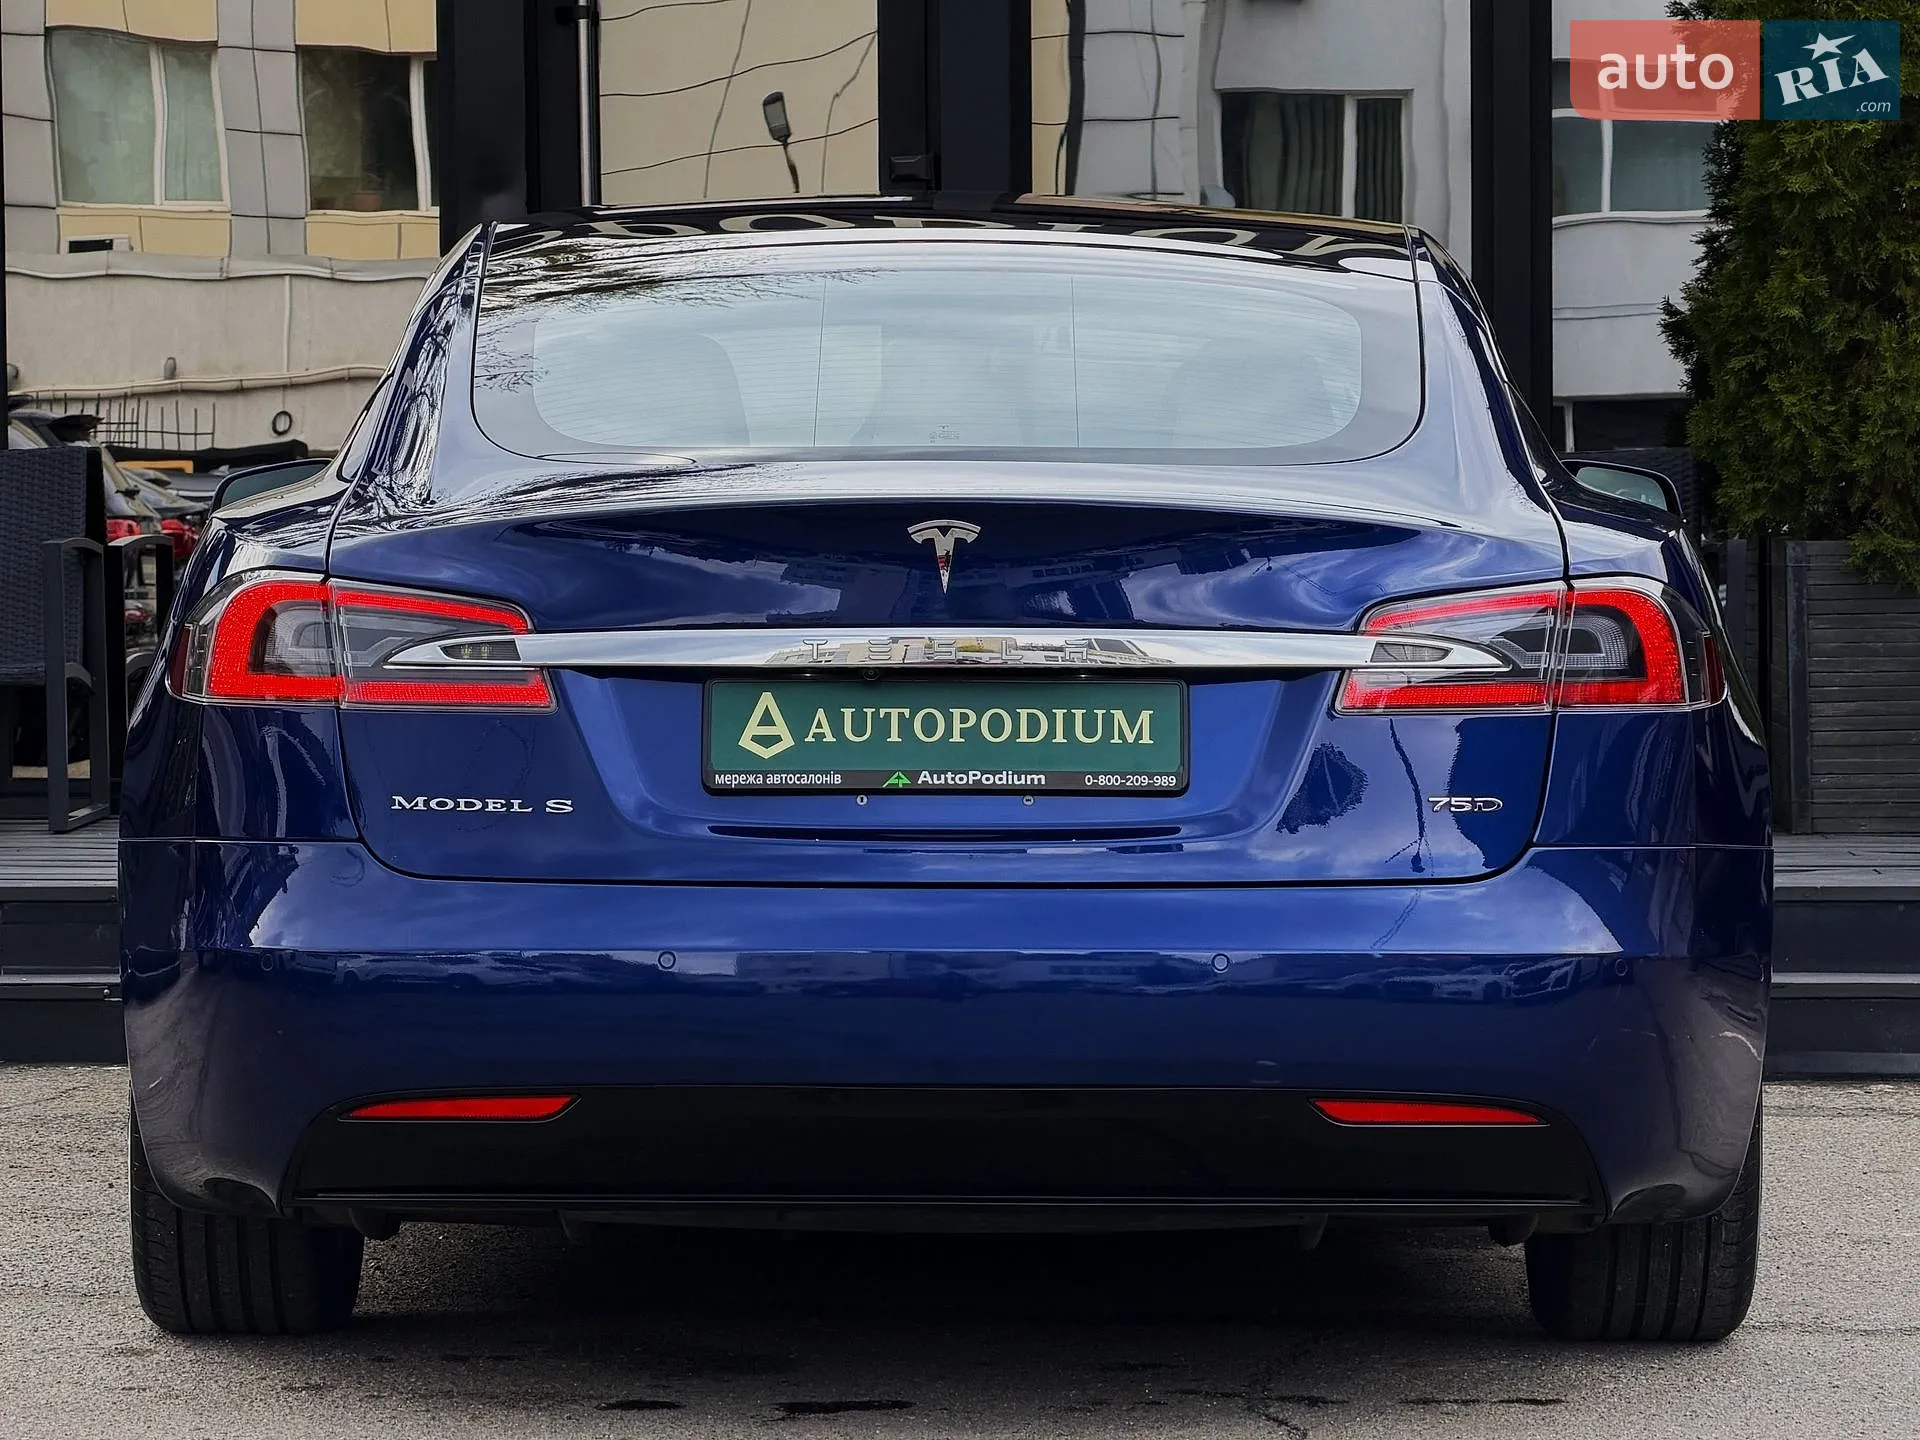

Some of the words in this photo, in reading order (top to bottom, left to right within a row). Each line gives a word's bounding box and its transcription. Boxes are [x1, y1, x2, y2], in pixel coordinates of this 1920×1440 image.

[802, 638, 1090, 661] TESLA
[803, 706, 1155, 745] AUTOPODIUM
[714, 773, 763, 788] мережа
[766, 770, 842, 785] автосалонів
[916, 770, 1047, 786] AutoPodium
[1084, 774, 1177, 787] 0-800-209-989
[390, 795, 534, 813] MODEL
[545, 799, 575, 814] S
[1427, 796, 1504, 813] 75D
